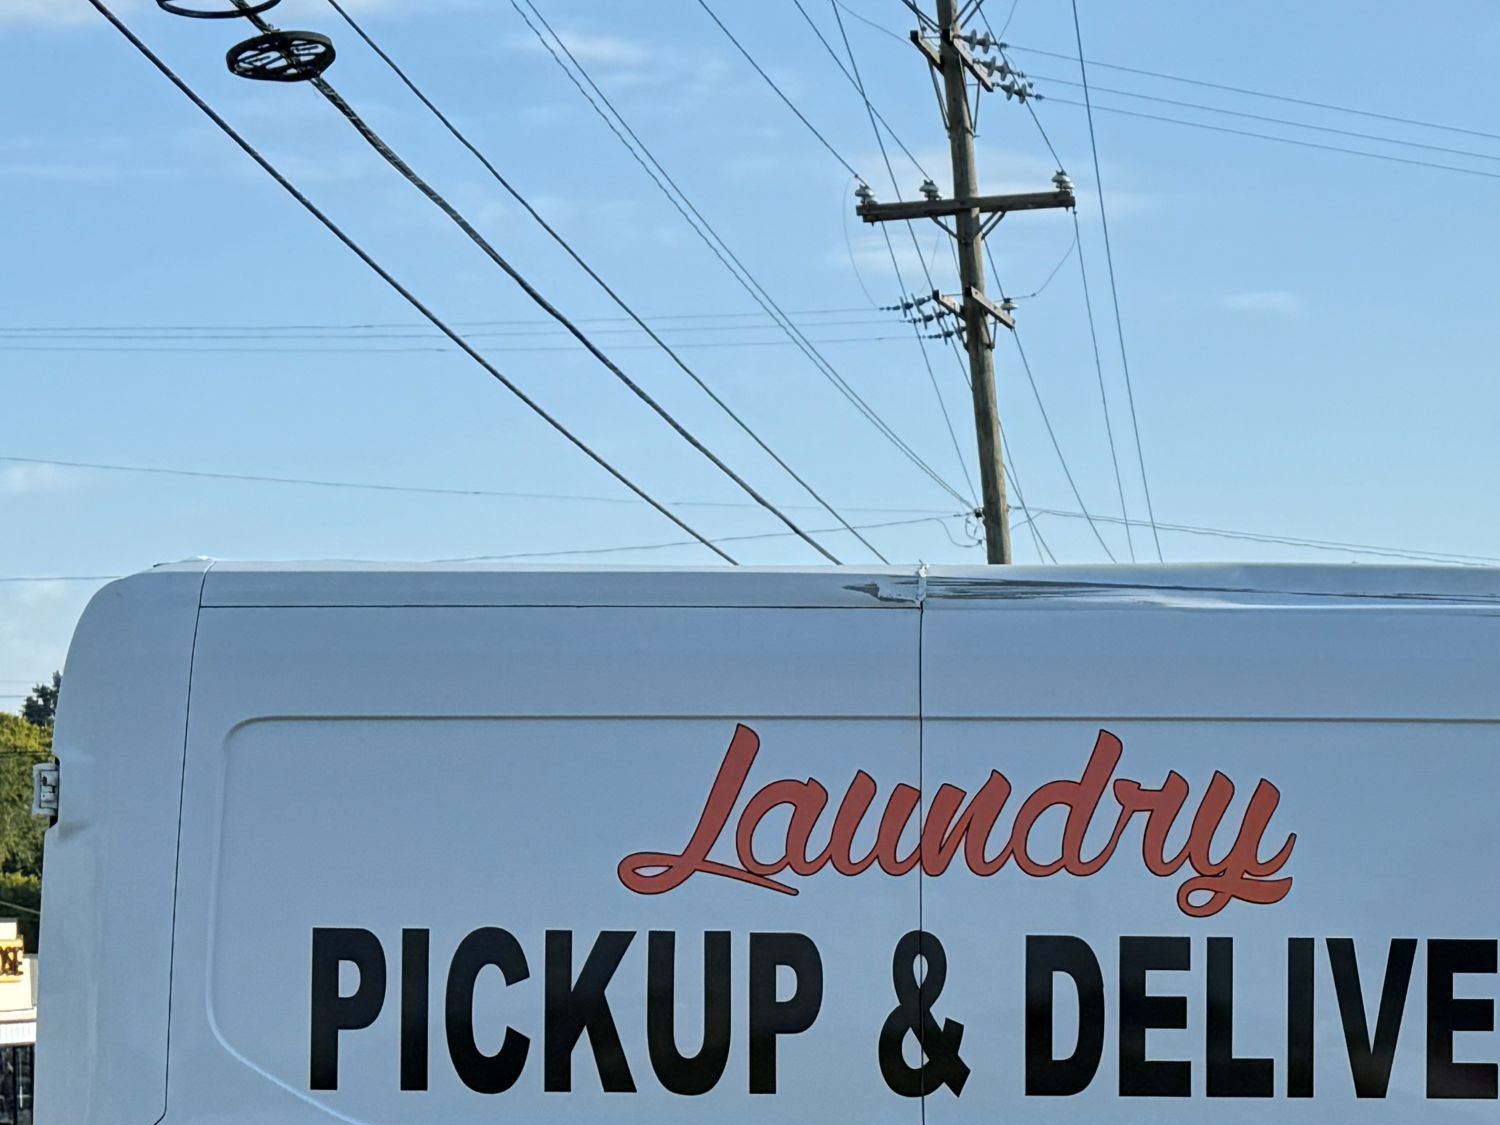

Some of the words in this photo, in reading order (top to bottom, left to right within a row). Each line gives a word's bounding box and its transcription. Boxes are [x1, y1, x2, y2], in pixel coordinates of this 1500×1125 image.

[618, 724, 1297, 918] Laundry
[309, 926, 824, 1097] PICKUP
[879, 928, 971, 1098] &
